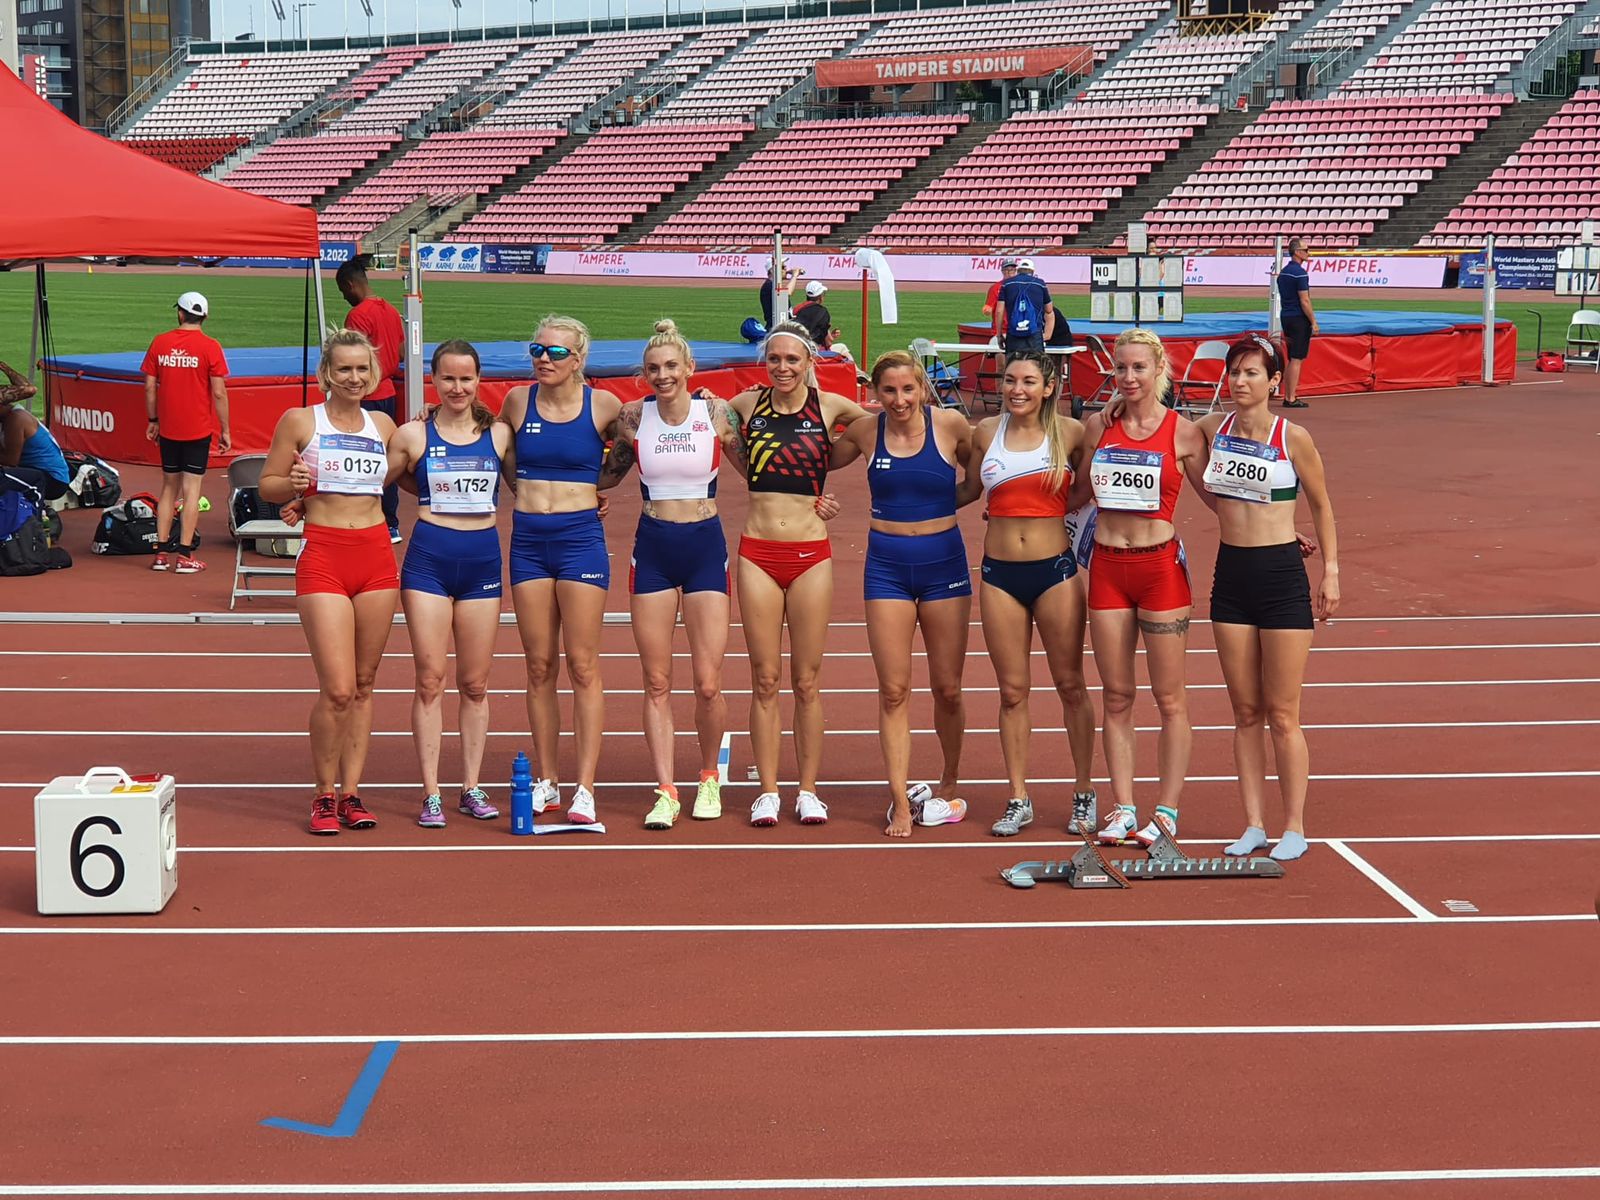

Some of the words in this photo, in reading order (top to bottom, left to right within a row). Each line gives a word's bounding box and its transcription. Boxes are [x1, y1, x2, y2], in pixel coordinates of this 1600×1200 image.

[875, 60, 948, 78] TAMPERE
[953, 56, 1025, 74] STADIUM
[34, 55, 48, 100] TINA
[698, 255, 750, 267] TAMPERE.
[1095, 266, 1109, 277] NO
[1345, 277, 1389, 285] FINLAND
[158, 355, 199, 368] MASTERS
[62, 405, 115, 433] MONDO
[658, 433, 692, 443] GREAT
[654, 444, 696, 454] BRITAIN
[324, 460, 340, 471] 35
[344, 457, 382, 475] 0137
[1212, 462, 1224, 473] 35
[1226, 460, 1267, 482] 2680
[435, 483, 450, 492] 35
[454, 478, 489, 493] 1752
[1094, 474, 1108, 486] 35
[1112, 471, 1154, 489] 2660
[70, 816, 125, 897] 6
